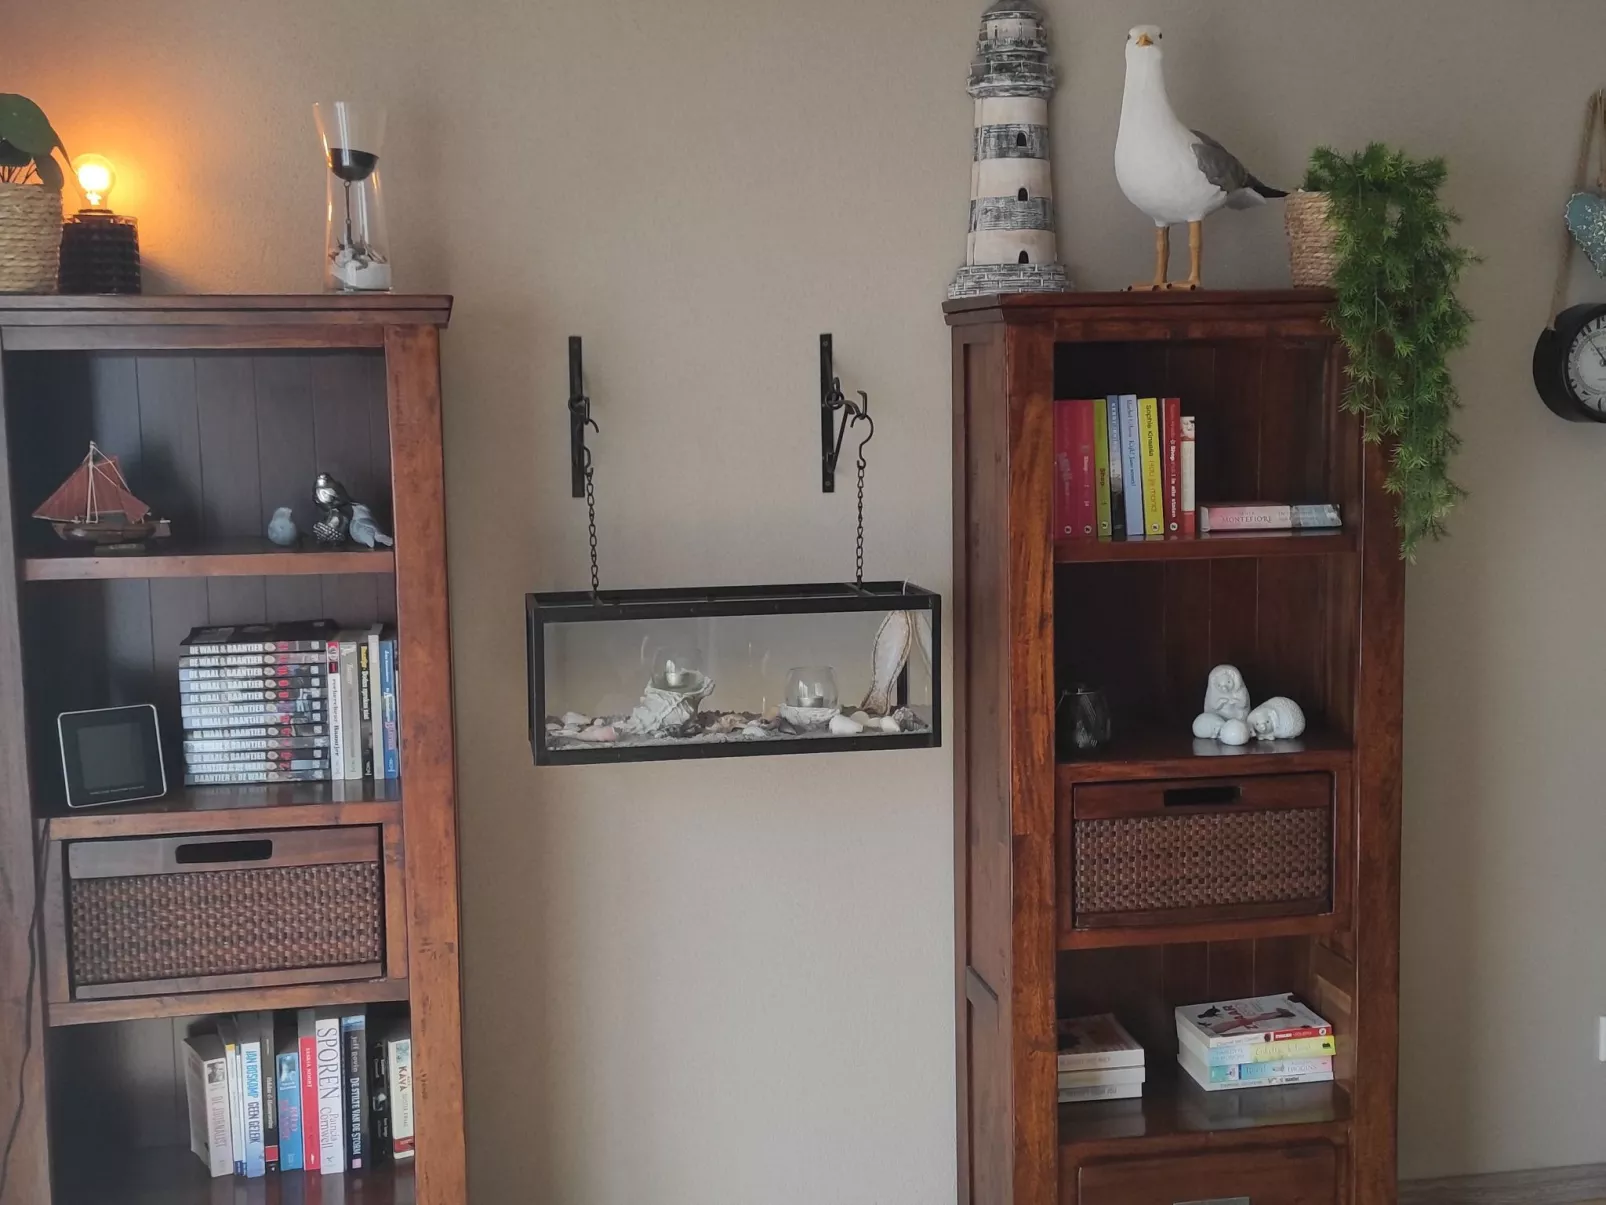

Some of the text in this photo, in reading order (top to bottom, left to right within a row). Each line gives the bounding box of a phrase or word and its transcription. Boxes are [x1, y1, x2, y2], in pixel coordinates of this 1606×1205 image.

[200, 645, 220, 654] WAAL
[200, 658, 219, 666] WAAL
[199, 670, 218, 678] WAAL
[246, 1050, 257, 1064] JAN
[317, 1028, 339, 1100] SPOREN
[246, 1065, 259, 1098] BOSKAMP
[398, 1066, 407, 1092] KAVA
[248, 1102, 260, 1120] GEEN
[350, 1077, 361, 1155] DE STILTE VAN DE STORM
[319, 1107, 334, 1149] Cornwell
[329, 1113, 339, 1142] Patricia
